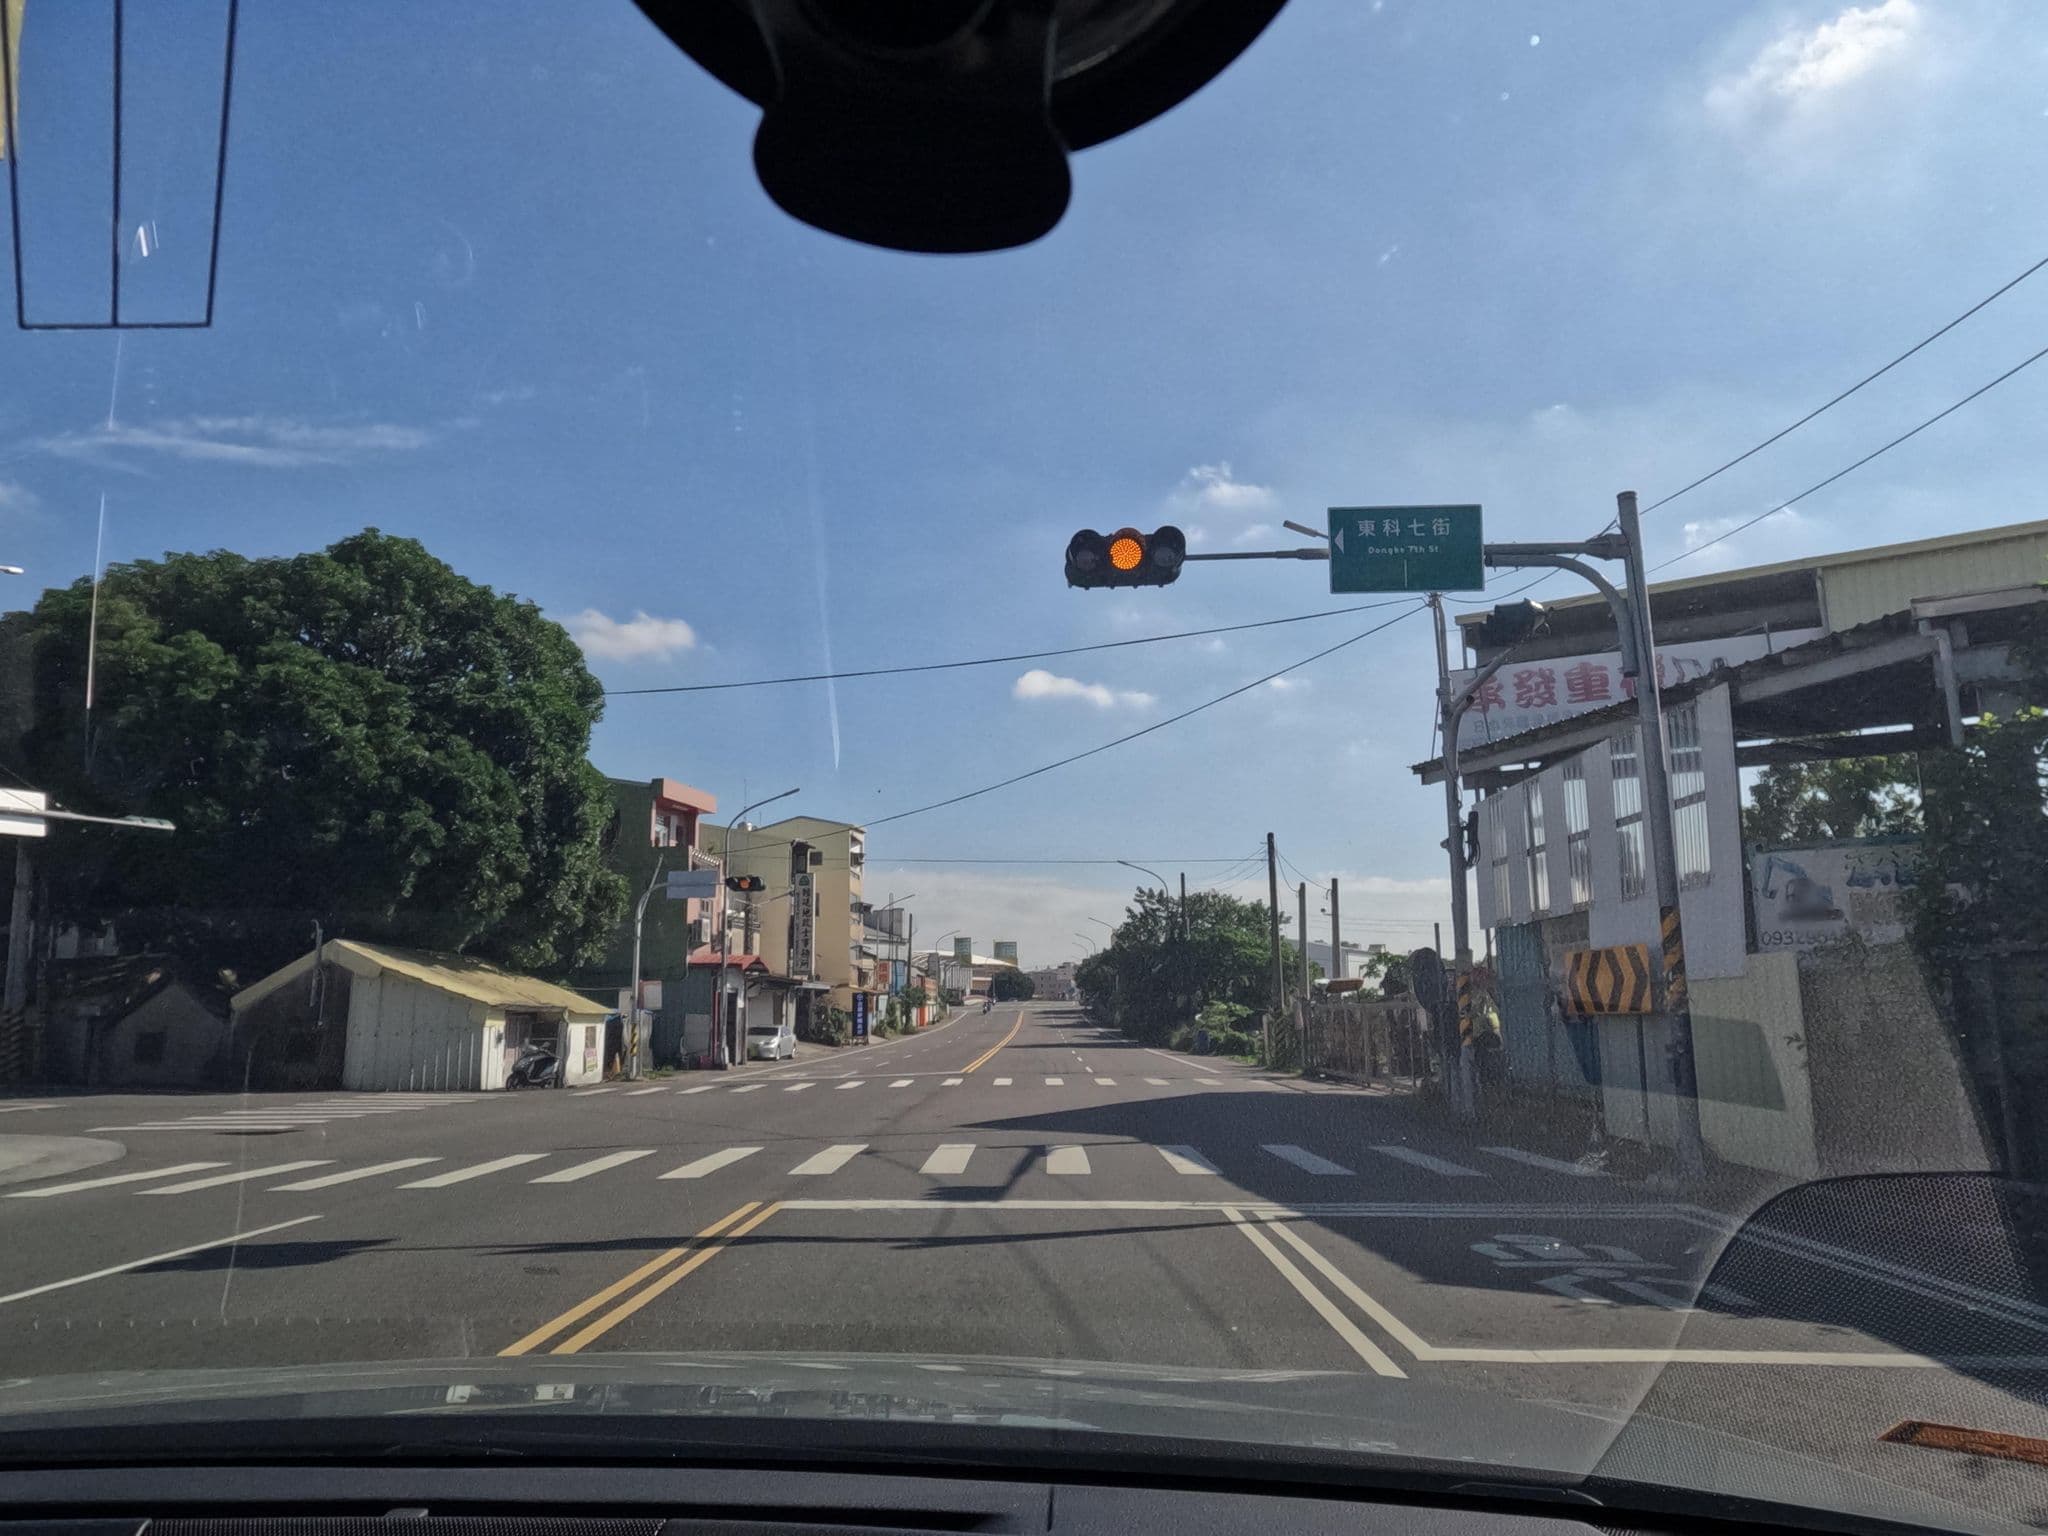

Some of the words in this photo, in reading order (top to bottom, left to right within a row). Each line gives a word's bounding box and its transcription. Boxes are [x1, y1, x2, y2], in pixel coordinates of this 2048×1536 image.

[1358, 518, 1450, 537] 東科七街
[1368, 545, 1405, 556] Dongke
[1408, 545, 1425, 554] 7th
[1429, 545, 1439, 553] St
